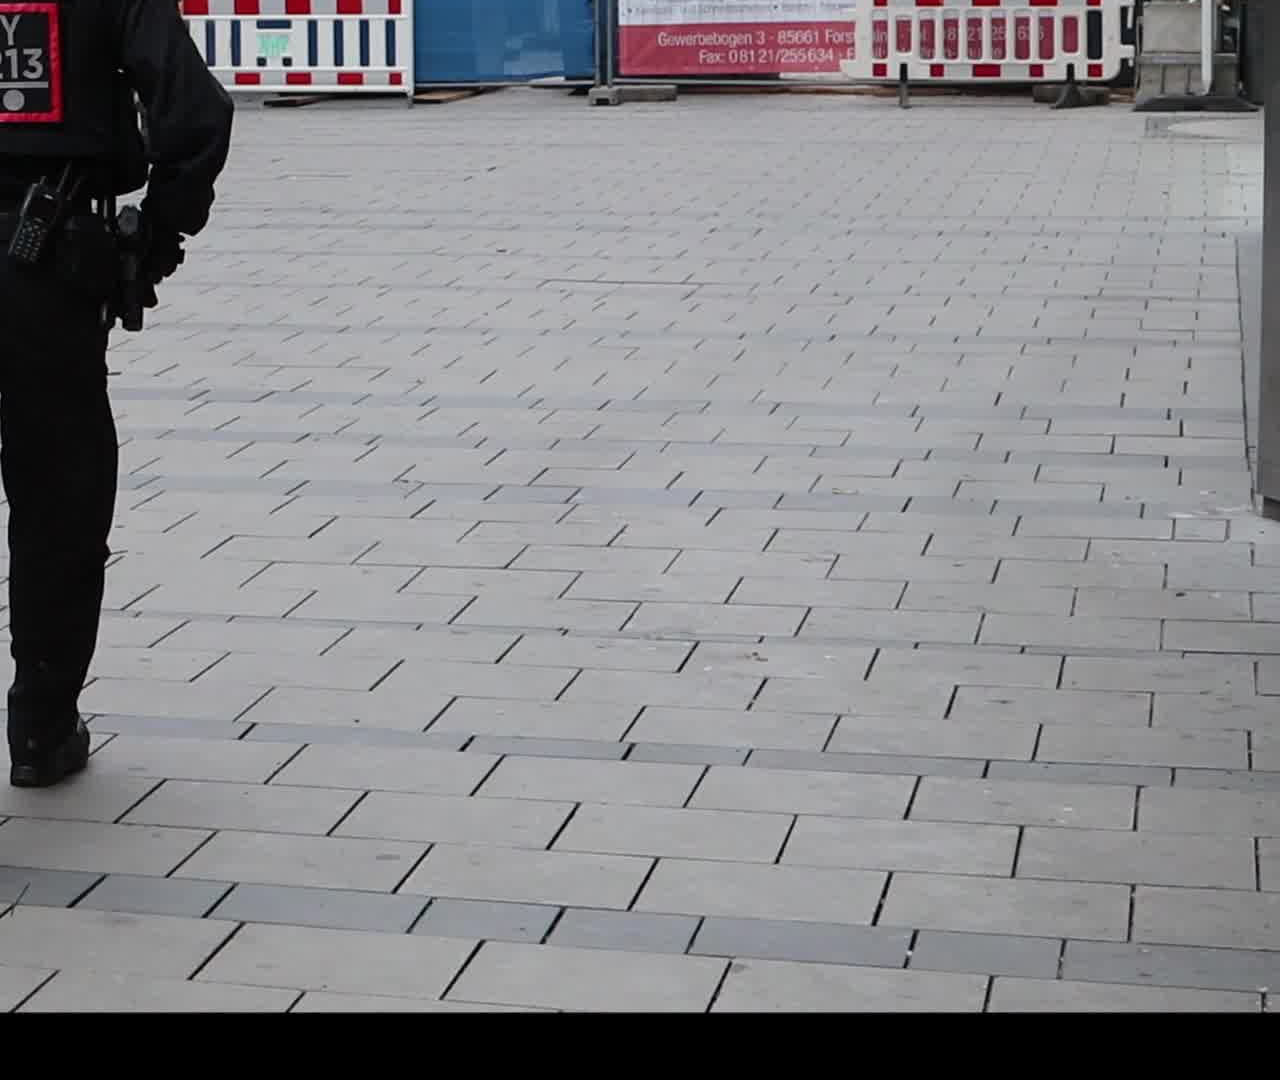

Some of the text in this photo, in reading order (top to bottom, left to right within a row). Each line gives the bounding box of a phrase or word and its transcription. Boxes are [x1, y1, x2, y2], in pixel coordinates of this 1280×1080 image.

[657, 31, 752, 48] Gewerbebogen
[756, 31, 766, 45] 3
[777, 30, 820, 45] 85661
[698, 49, 724, 64] Fax:
